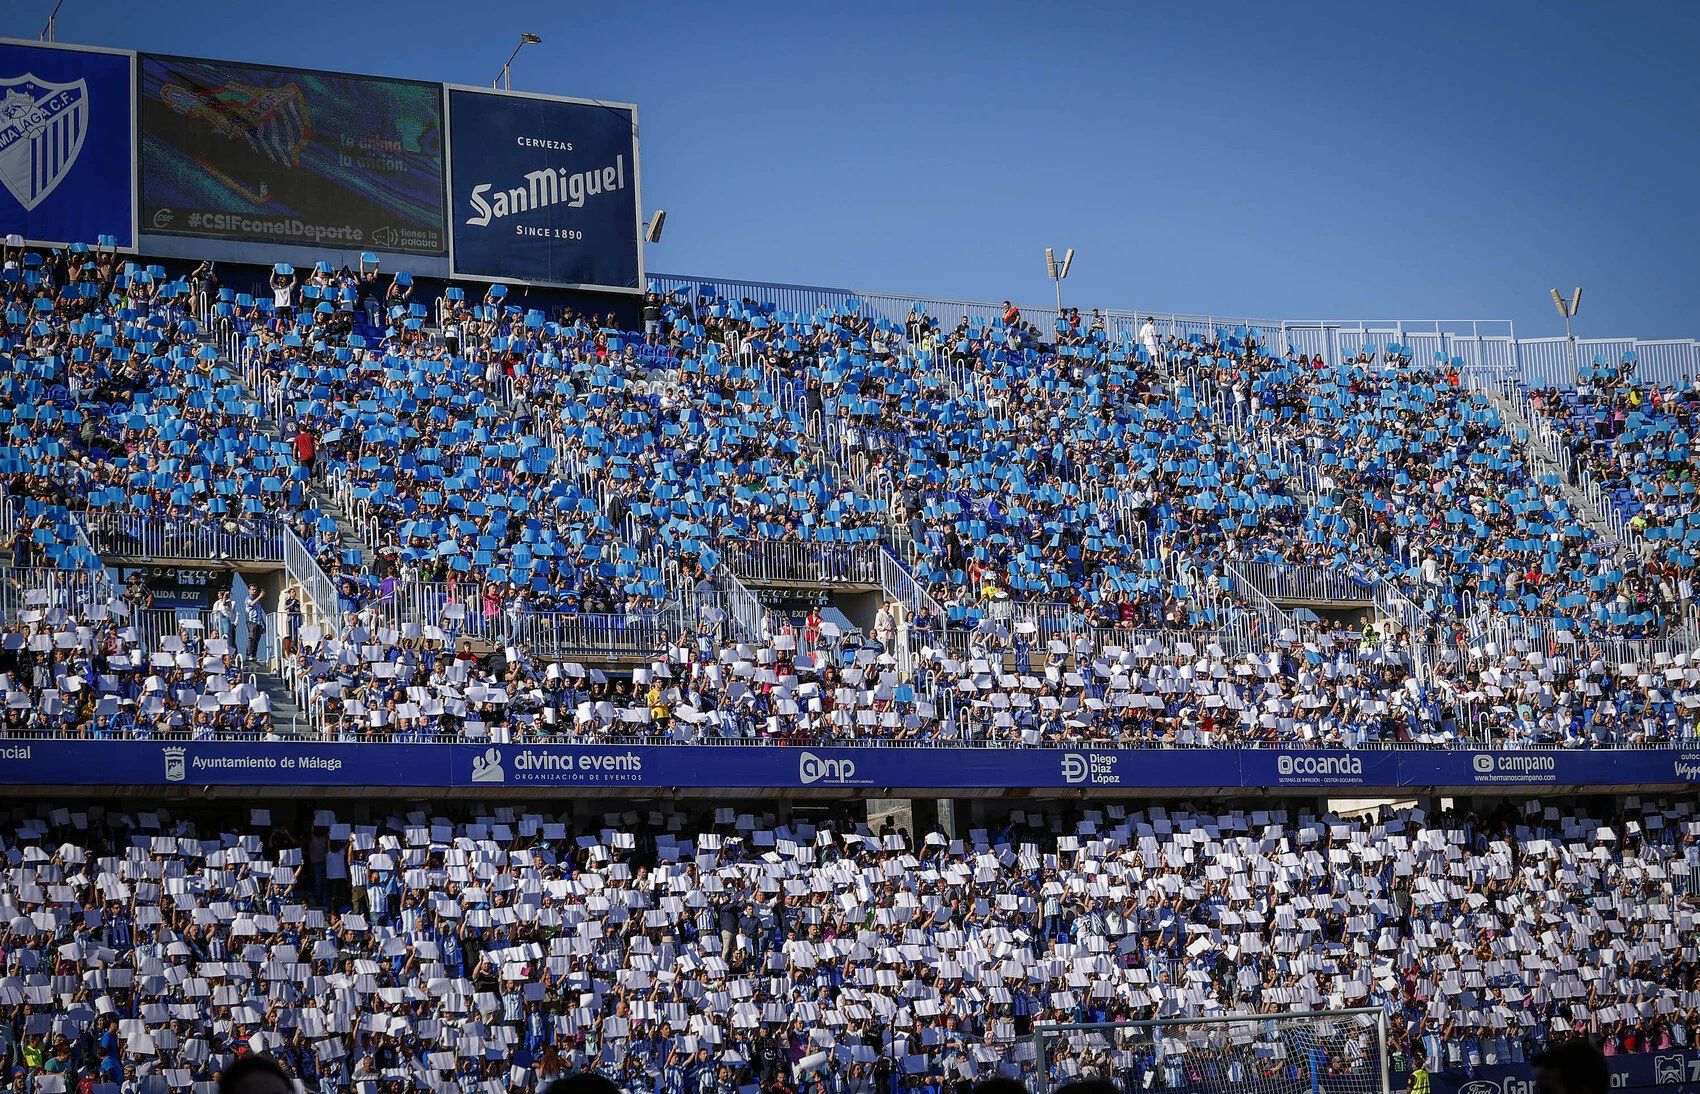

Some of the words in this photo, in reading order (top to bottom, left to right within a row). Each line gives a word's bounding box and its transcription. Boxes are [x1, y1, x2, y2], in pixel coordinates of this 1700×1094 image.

[50, 92, 74, 111] C.F.
[517, 136, 574, 151] CERVEZAS
[189, 212, 363, 241] #CSIFconelDeporte
[516, 225, 550, 237] SINCE
[554, 228, 582, 240] 1890
[401, 228, 427, 239] tienes
[428, 230, 438, 239] la
[401, 238, 438, 248] palabra
[151, 590, 176, 599] ALIDA
[181, 591, 200, 600] EXIT
[791, 609, 808, 618] EXIT
[0, 745, 31, 759] ncial
[192, 755, 277, 770] Ayuntamiento
[280, 756, 295, 769] de
[298, 756, 342, 771] Málaga
[514, 750, 574, 770] divina
[578, 752, 642, 771] events
[1090, 753, 1118, 764] Diego
[1293, 753, 1362, 774] coanda
[1498, 755, 1555, 774] campano
[1090, 764, 1112, 773] Díaz
[515, 771, 586, 781] ORGANIZACIÓN
[589, 773, 599, 781] DE
[603, 773, 643, 782] EVENTOS
[1091, 773, 1121, 784] López
[1474, 774, 1557, 782] www.hermanoscampano.com
